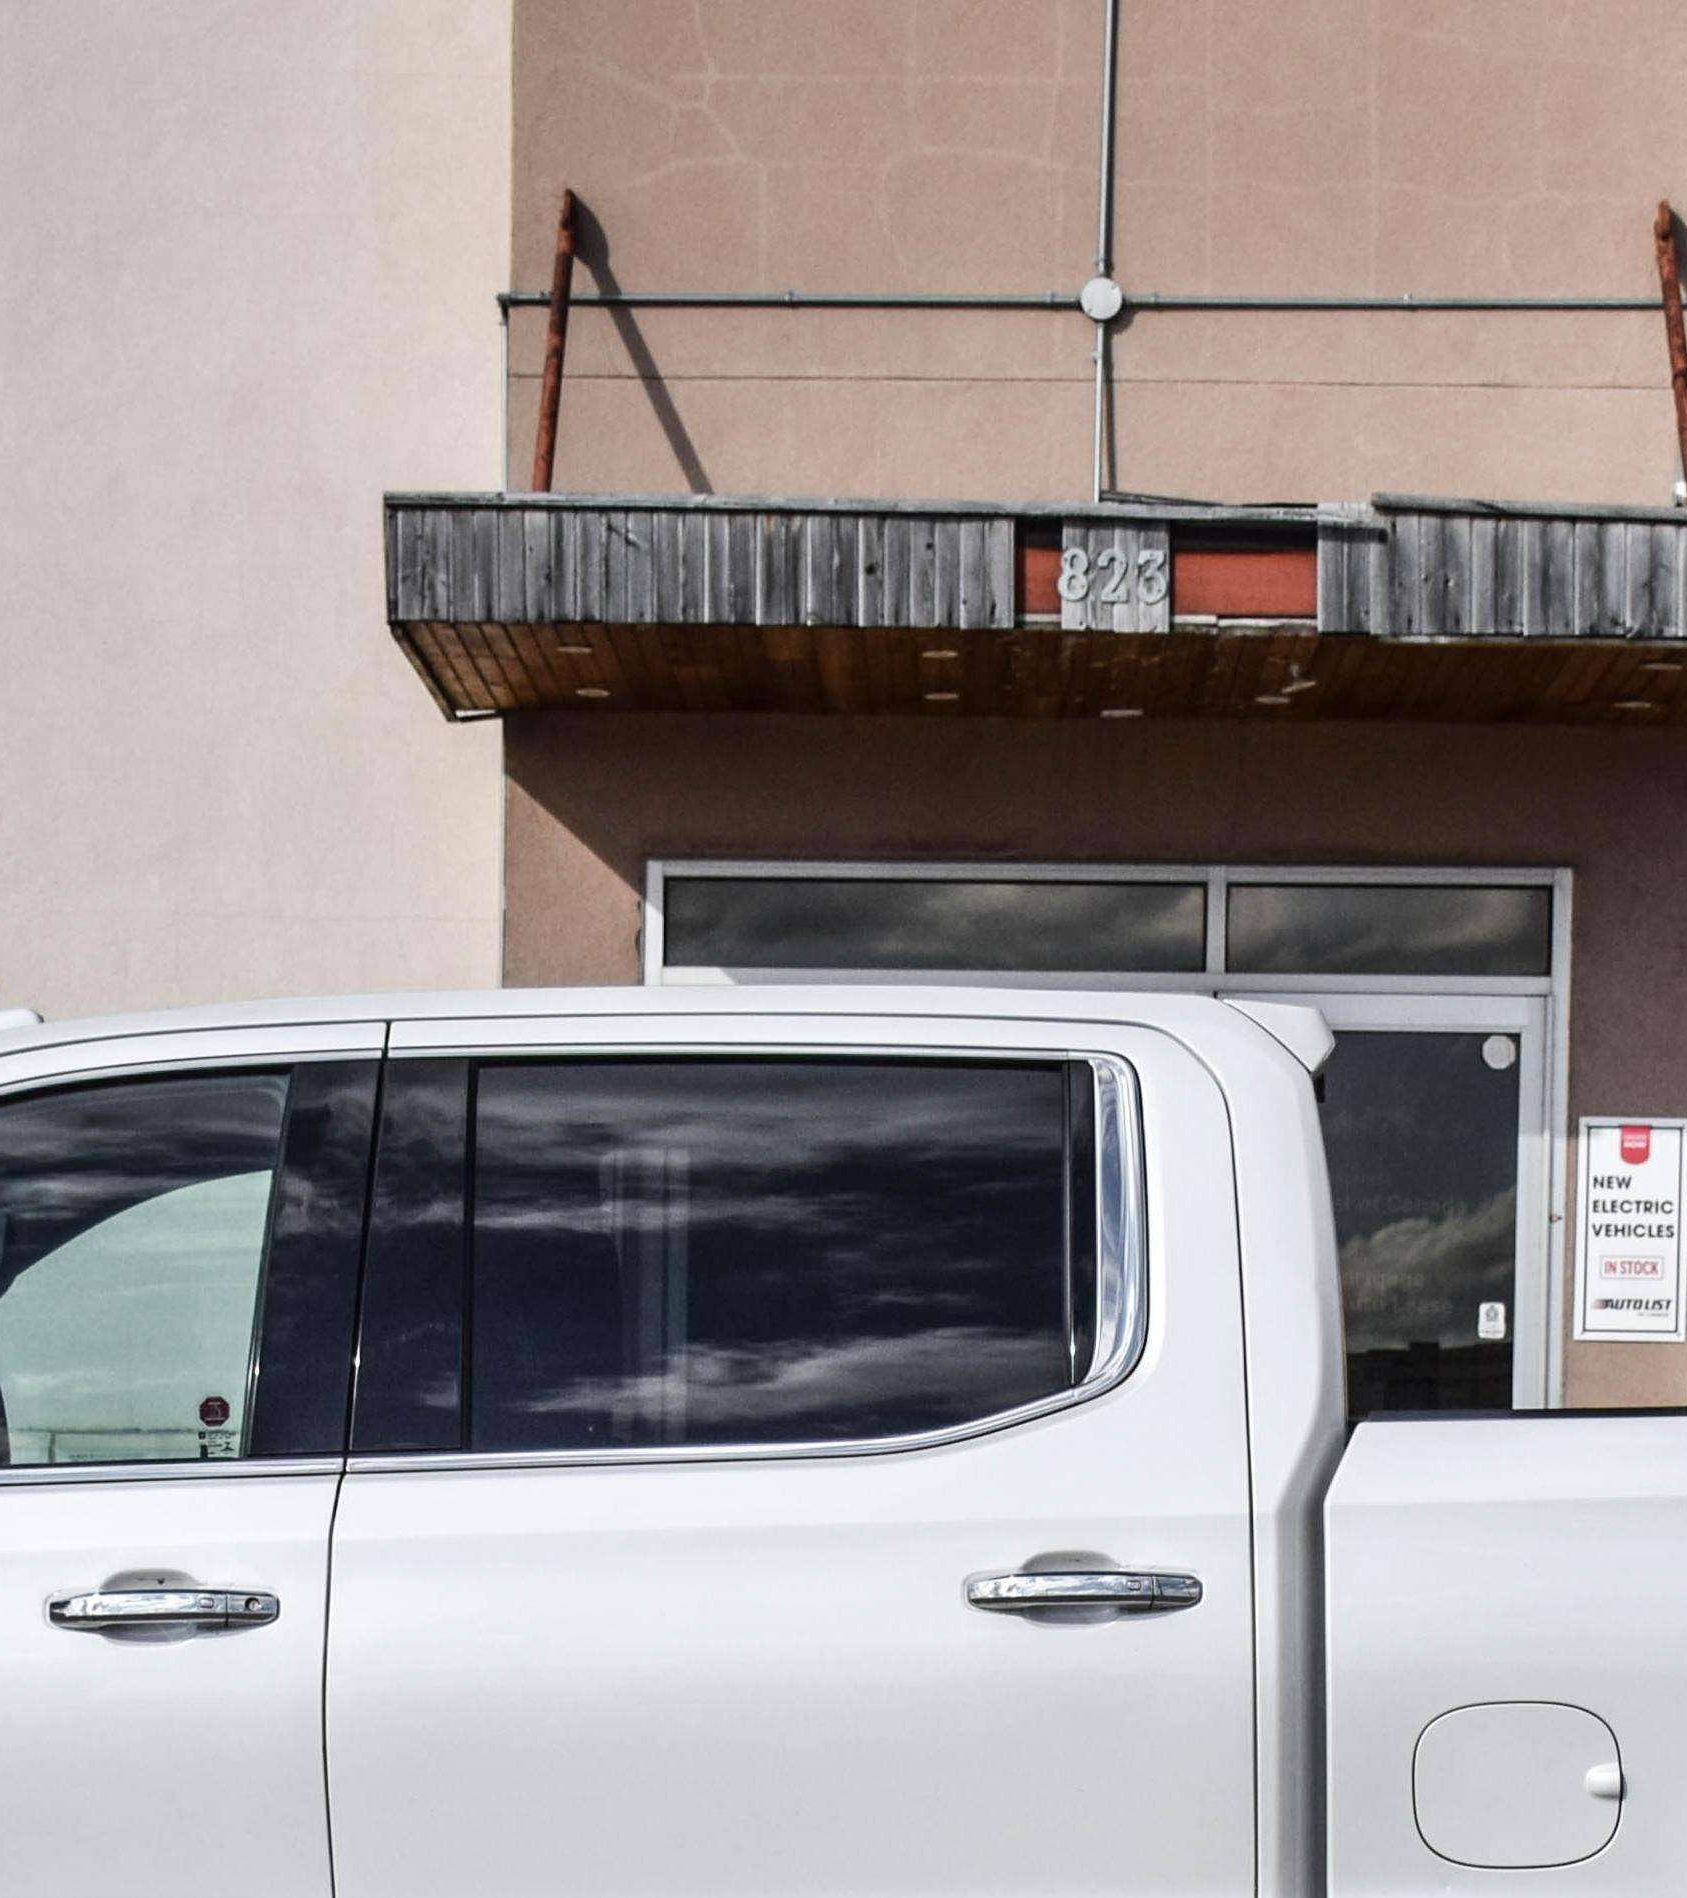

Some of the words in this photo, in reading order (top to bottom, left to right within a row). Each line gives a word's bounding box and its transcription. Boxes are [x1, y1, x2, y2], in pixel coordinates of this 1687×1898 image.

[1056, 547, 1170, 604] 823
[1592, 1175, 1632, 1190] NEW
[1592, 1199, 1674, 1215] ELECTRIC
[1592, 1223, 1675, 1239] VEHICLES
[1604, 1261, 1617, 1275] IN
[1620, 1260, 1660, 1276] STOCK
